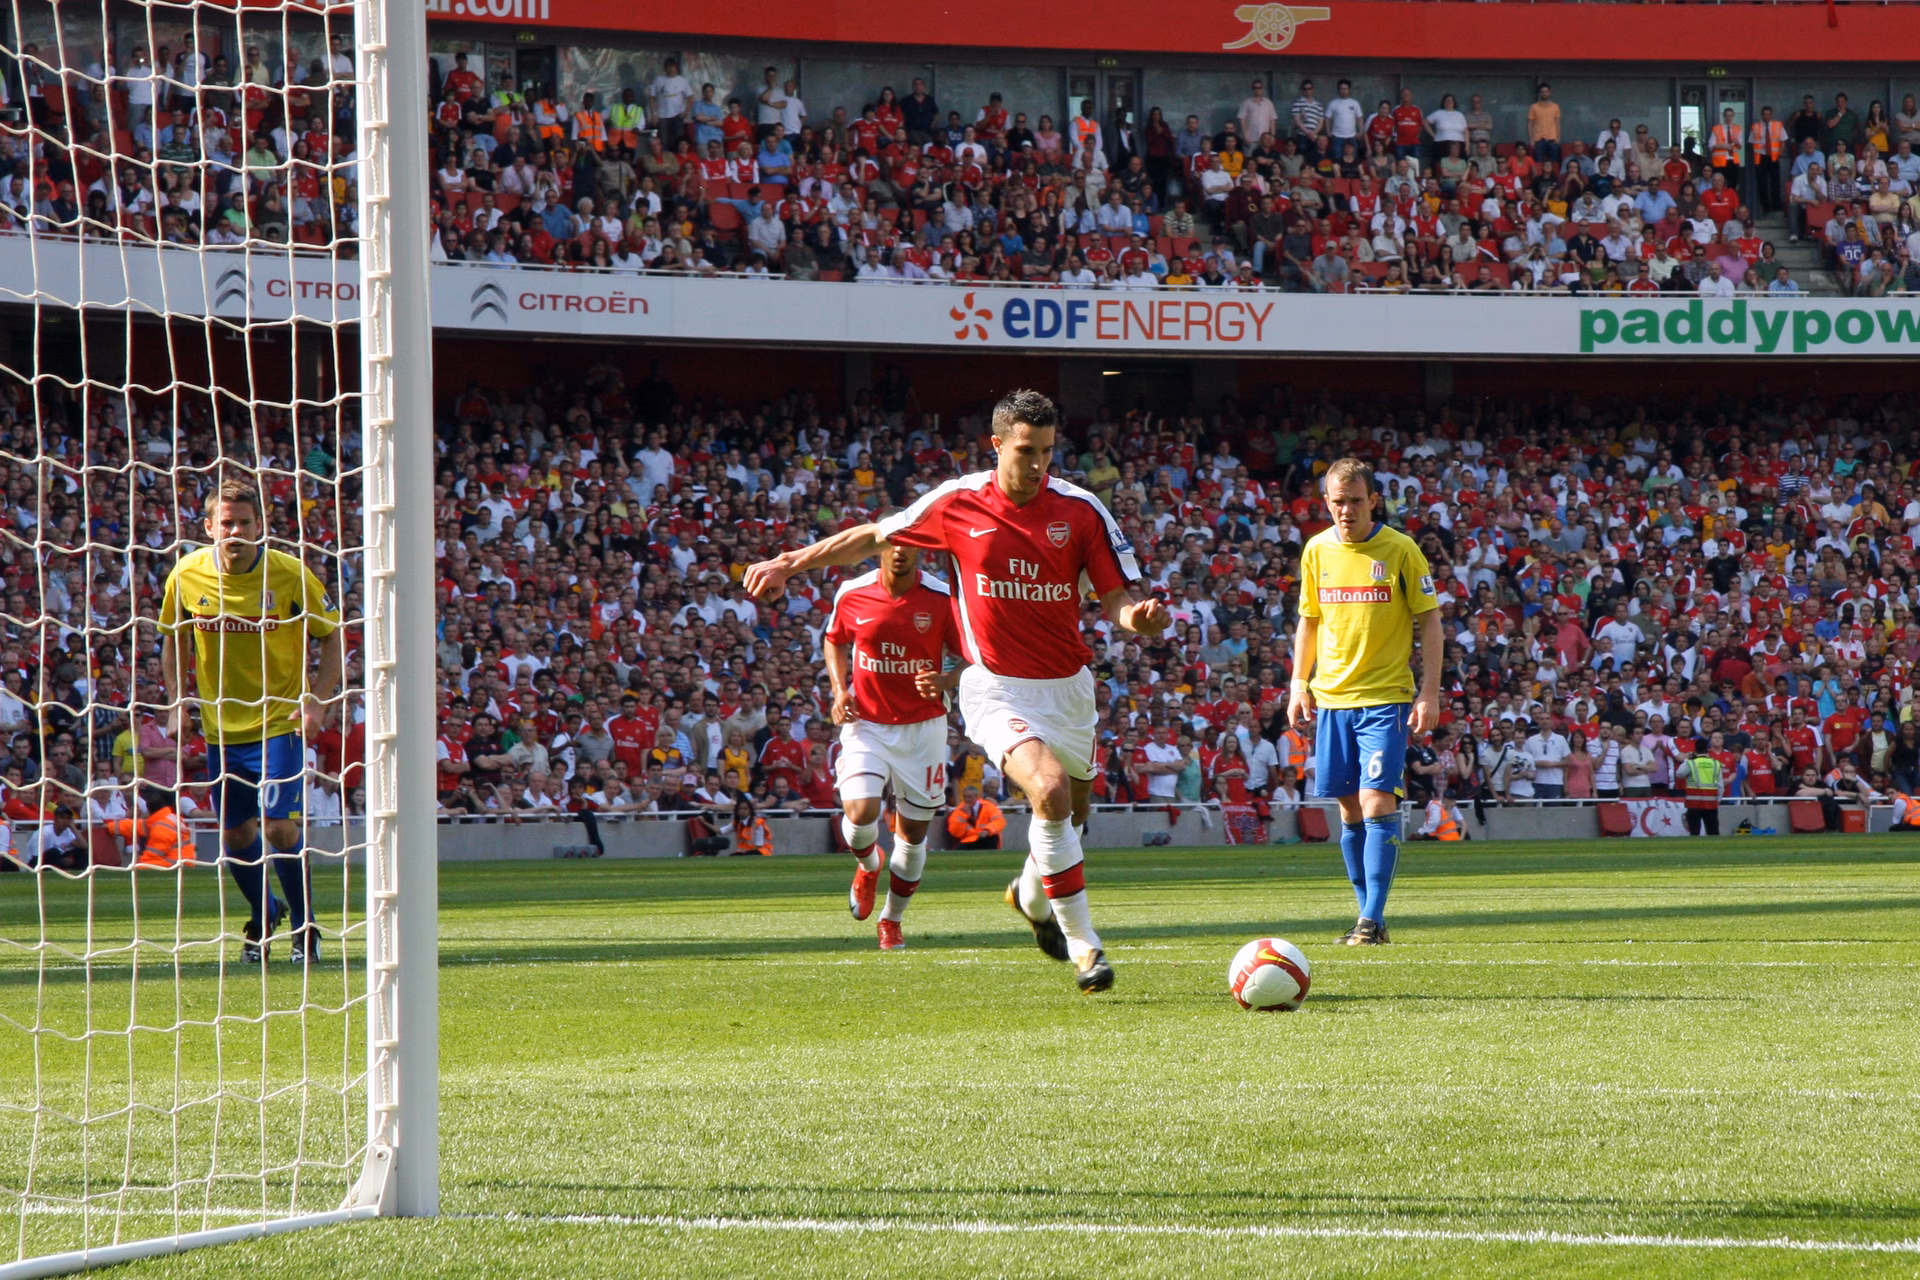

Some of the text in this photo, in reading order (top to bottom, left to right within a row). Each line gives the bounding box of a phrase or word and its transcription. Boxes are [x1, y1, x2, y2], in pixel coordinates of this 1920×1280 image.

[266, 279, 360, 301] CITRO
[1096, 300, 1274, 342] ENERGY
[1579, 299, 1920, 353] paddypow
[1008, 558, 1039, 580] Fly
[976, 573, 1072, 602] Emirates
[1319, 588, 1389, 603] Britannia
[858, 650, 934, 674] Emirates
[881, 642, 906, 658] Fly
[925, 762, 944, 791] 14
[1367, 750, 1384, 779] 6
